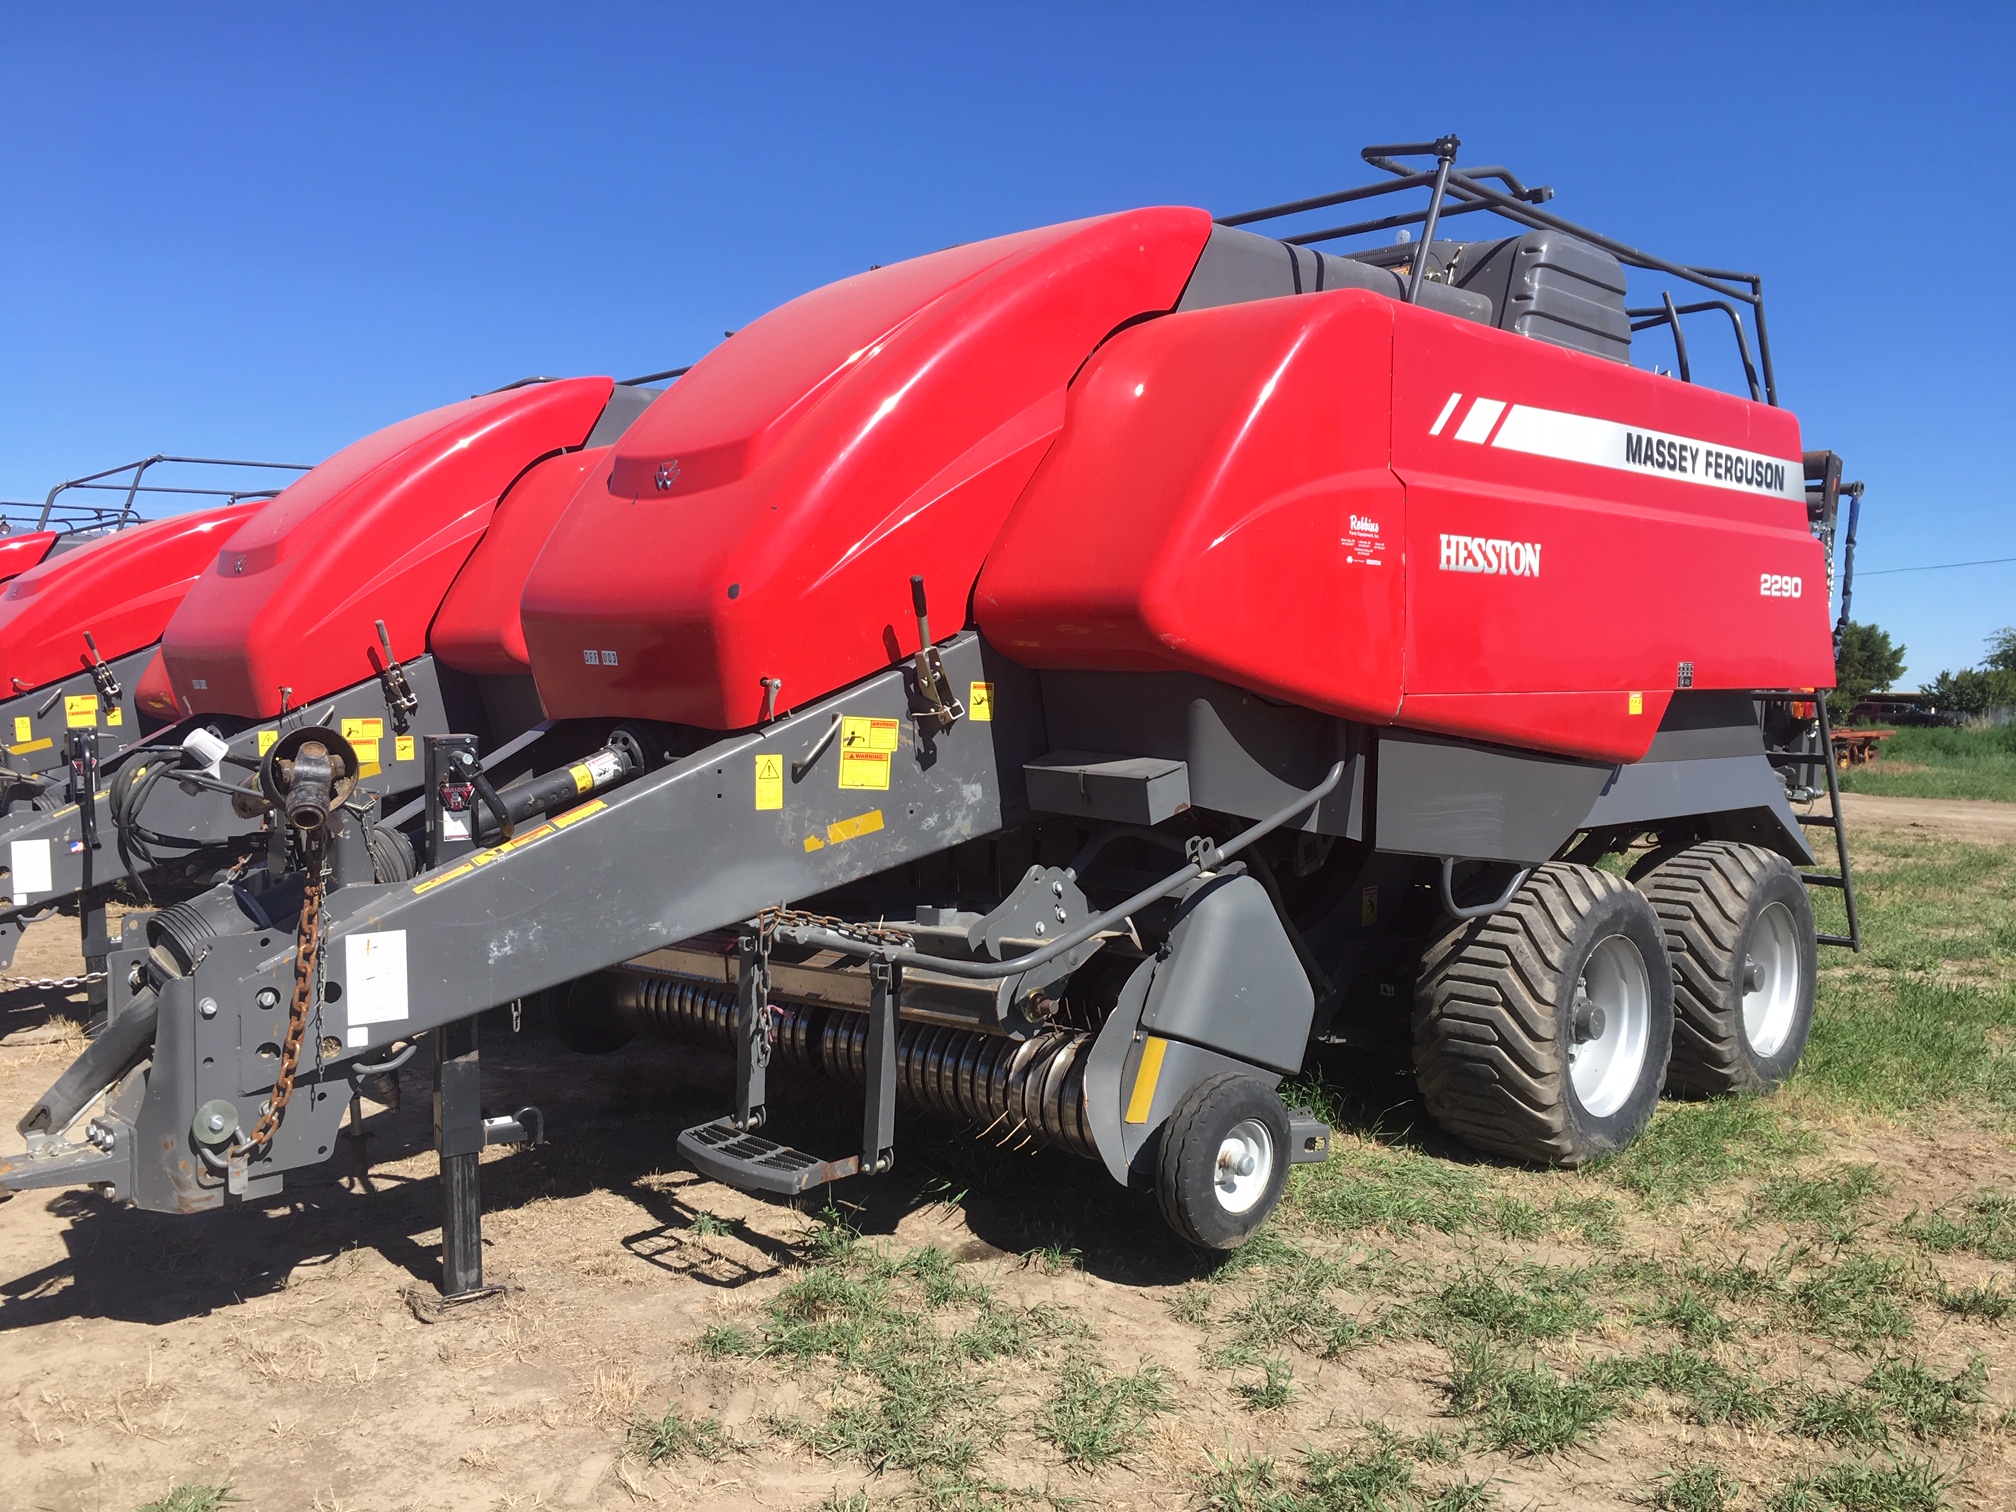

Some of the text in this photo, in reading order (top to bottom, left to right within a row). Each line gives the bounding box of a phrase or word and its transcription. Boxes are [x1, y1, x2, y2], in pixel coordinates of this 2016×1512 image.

[1626, 432, 1785, 492] MASSEY FERGUSON
[1350, 514, 1379, 533] Robbins
[1439, 533, 1541, 578] HESSTON
[1760, 573, 1802, 598] 2290
